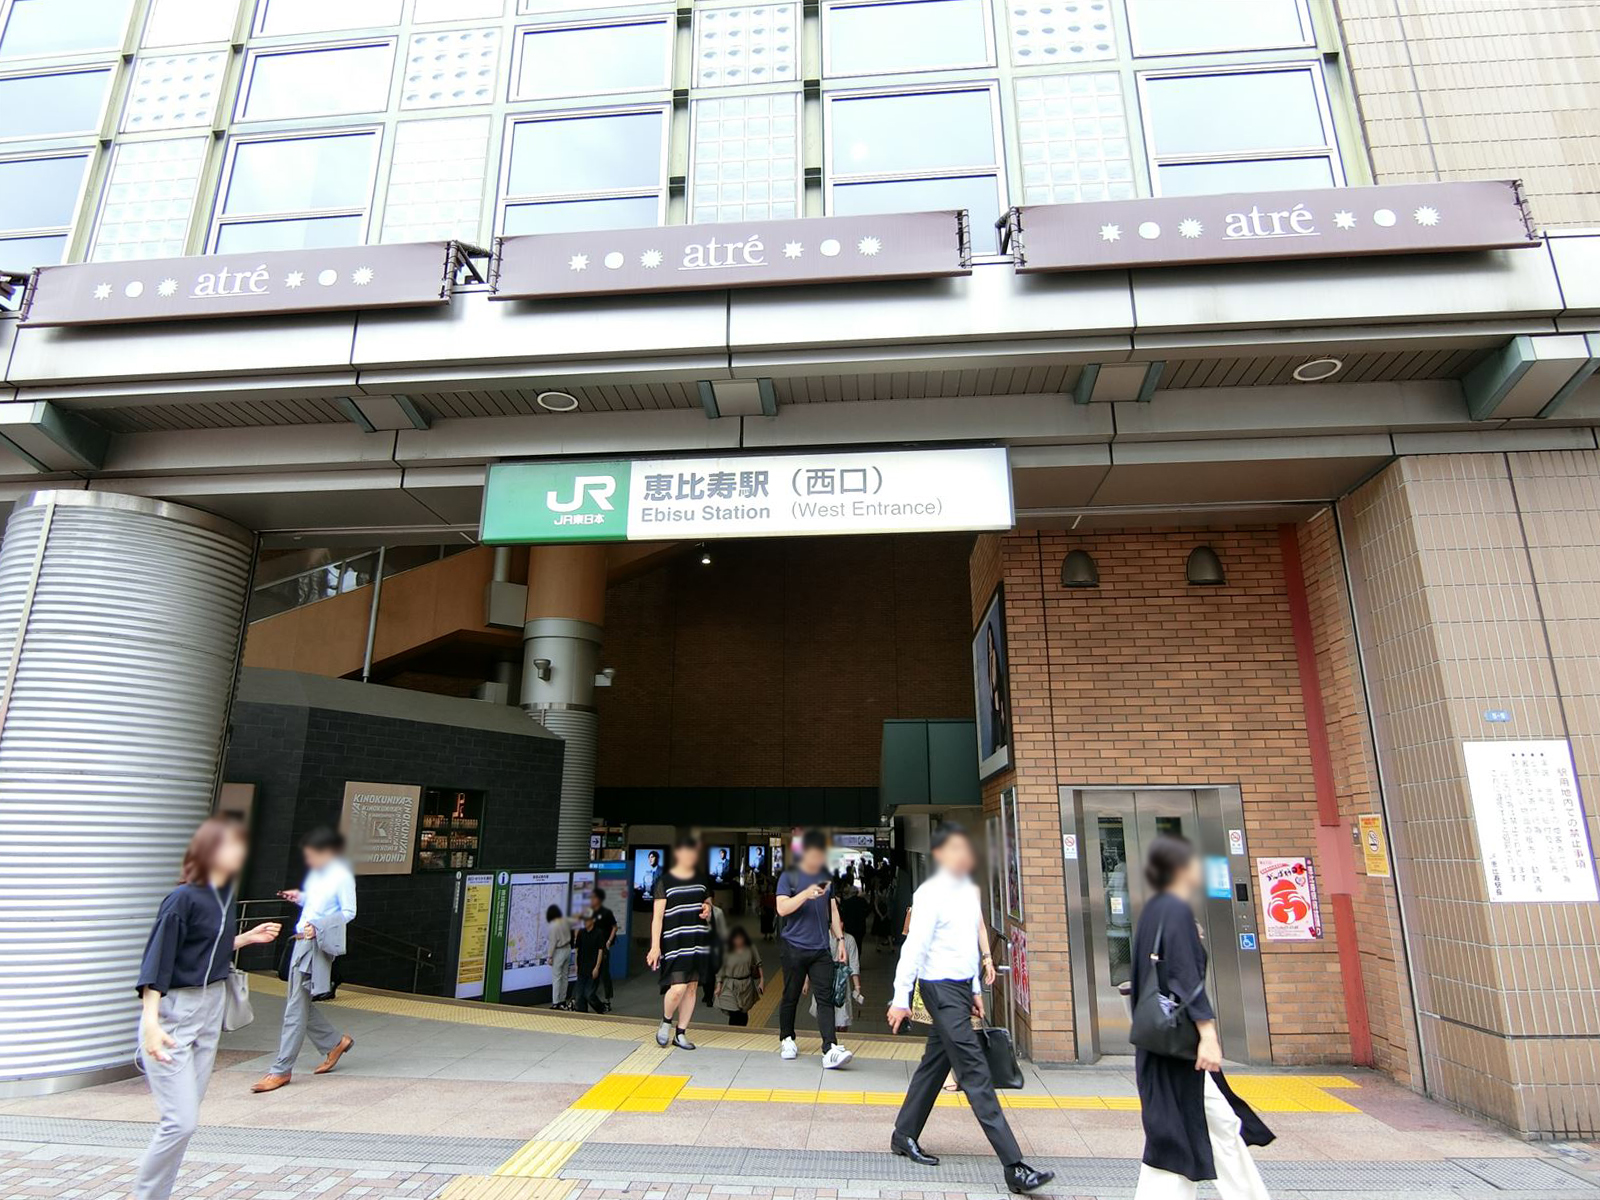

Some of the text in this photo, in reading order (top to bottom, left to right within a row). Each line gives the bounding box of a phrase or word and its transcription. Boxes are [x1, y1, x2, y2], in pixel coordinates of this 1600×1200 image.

[1225, 203, 1314, 238] atré
[682, 234, 765, 268] atré
[194, 263, 270, 296] atré
[546, 475, 616, 513] JR
[643, 469, 769, 502] 恵比寿駅
[553, 512, 605, 526] JR東日本
[641, 498, 943, 523] Ebisu Station (West Entrance)
[353, 793, 406, 805] KINOKUNIYA
